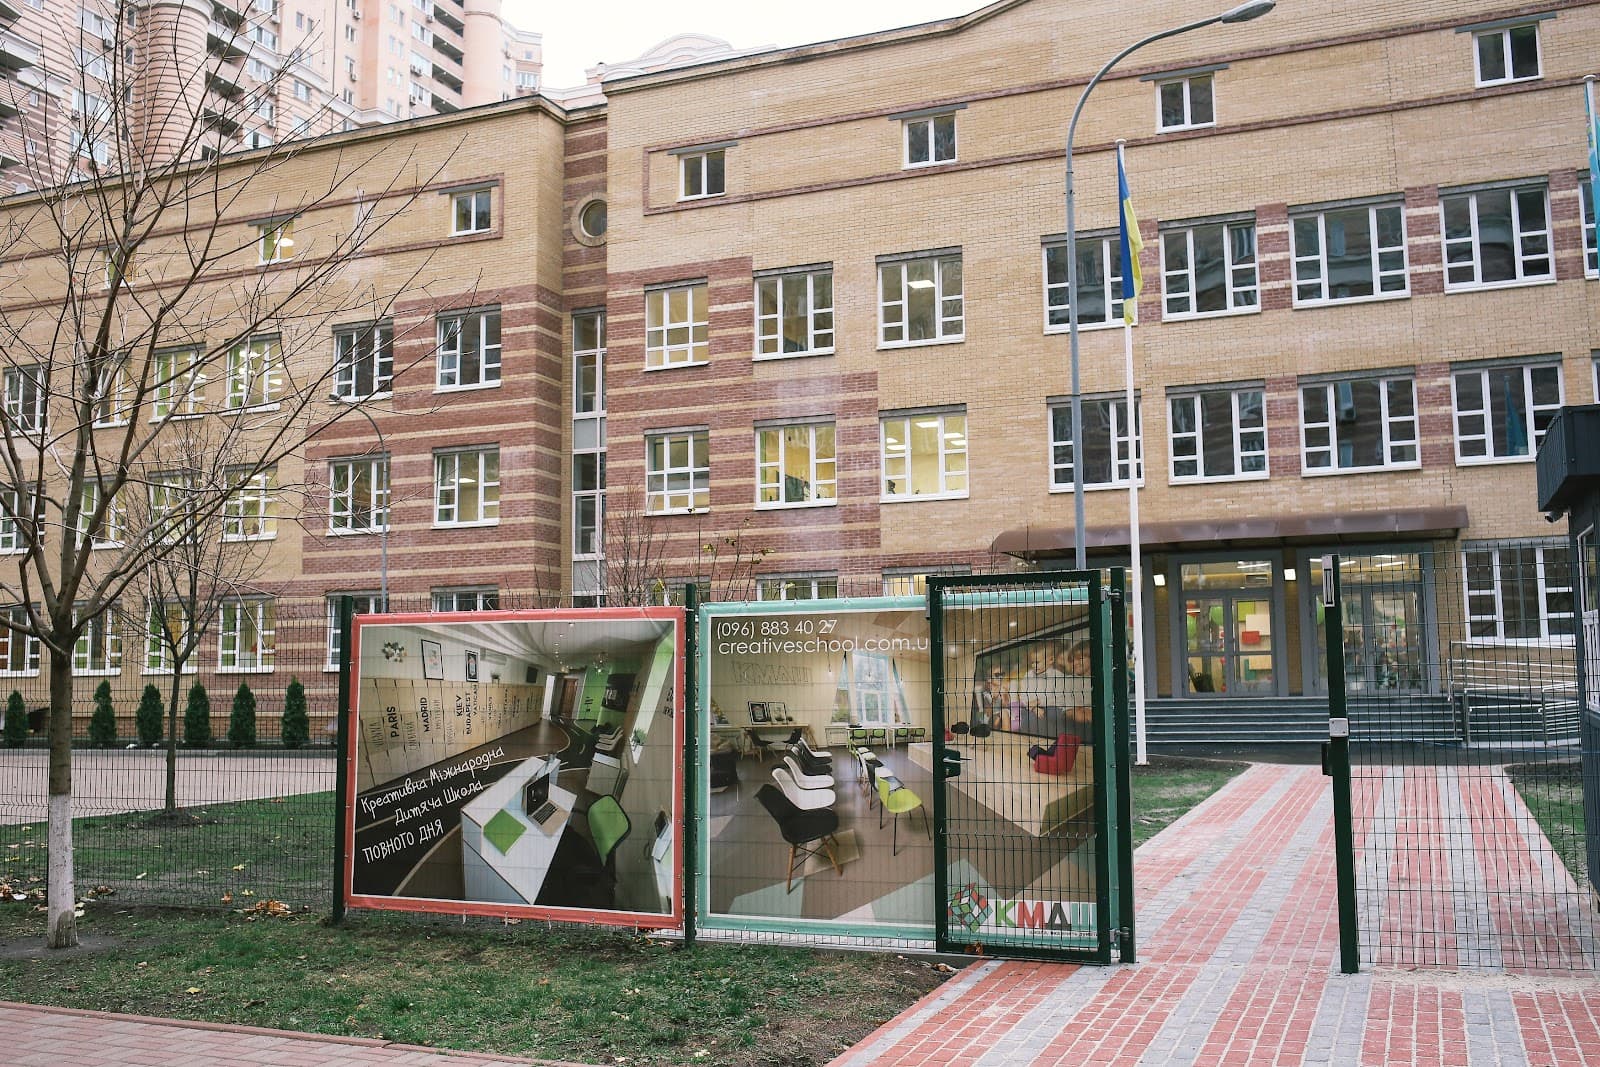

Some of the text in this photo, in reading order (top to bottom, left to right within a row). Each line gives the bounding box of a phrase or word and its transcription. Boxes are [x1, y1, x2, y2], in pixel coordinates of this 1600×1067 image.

[717, 619, 838, 639] (096) 883 40 27
[718, 635, 929, 655] creativeschool.com.u
[387, 706, 400, 738] PARIS
[420, 697, 430, 733] MADRID
[361, 747, 504, 819] Креативна Міжнародна
[395, 780, 483, 826] Дитяча Школа
[362, 819, 444, 863] ПОВНОГО ДНЯ
